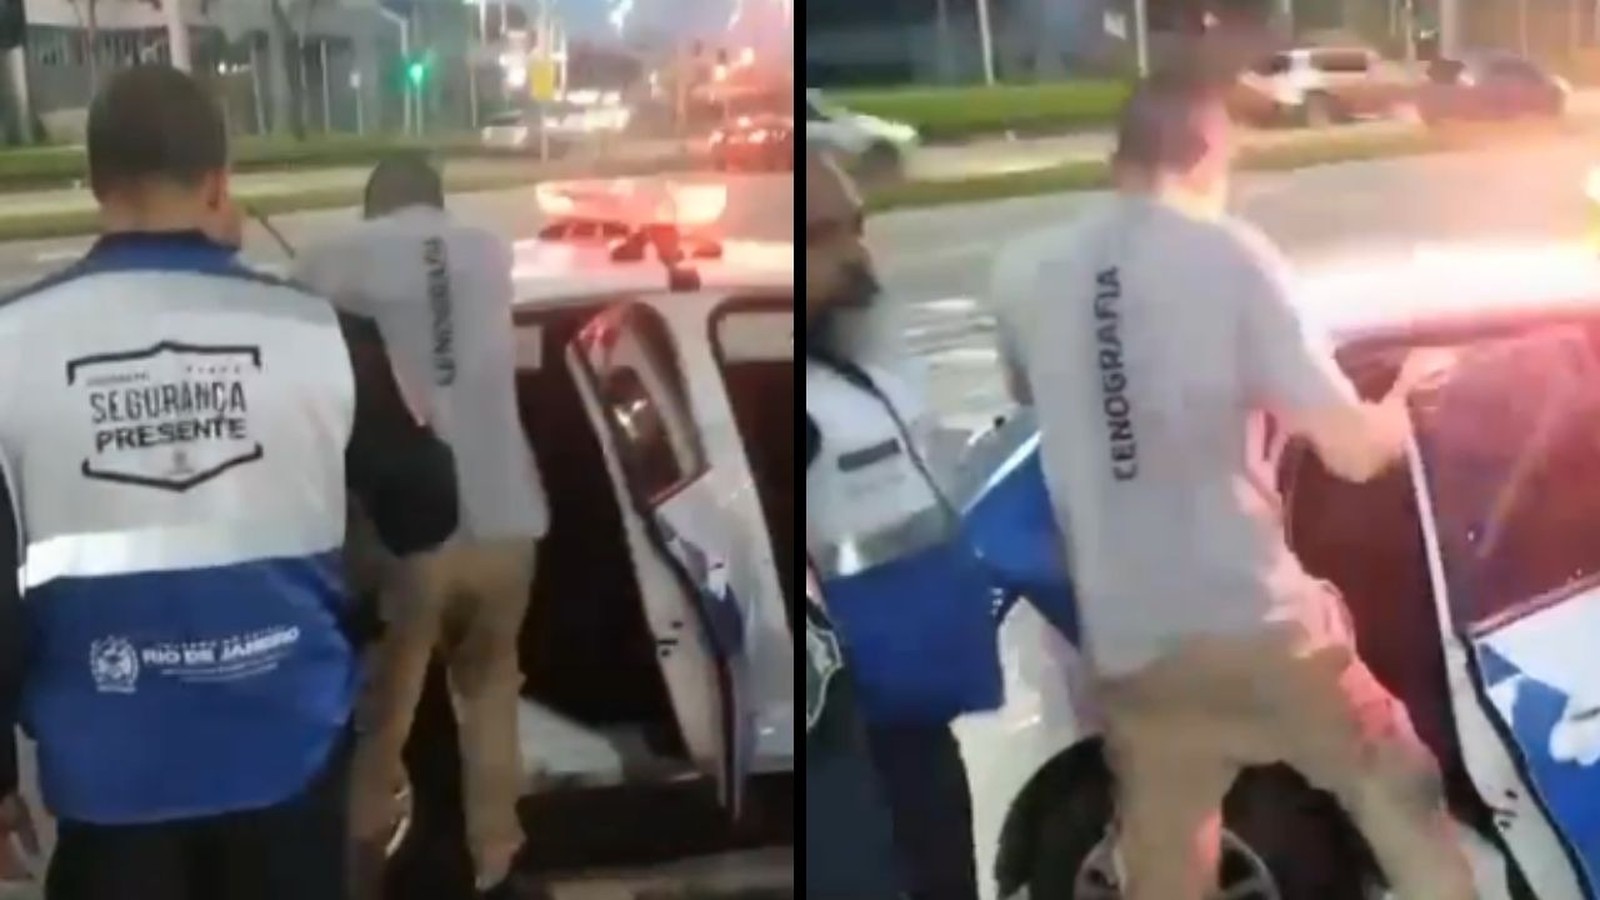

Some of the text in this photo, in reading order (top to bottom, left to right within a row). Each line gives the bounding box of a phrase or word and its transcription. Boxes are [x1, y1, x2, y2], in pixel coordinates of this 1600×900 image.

[1094, 266, 1138, 481] CENOGRAFIA
[90, 381, 247, 424] SEGURANÇA
[96, 418, 246, 453] PRESENTE
[142, 648, 181, 665] RIO
[184, 649, 215, 664] DE
